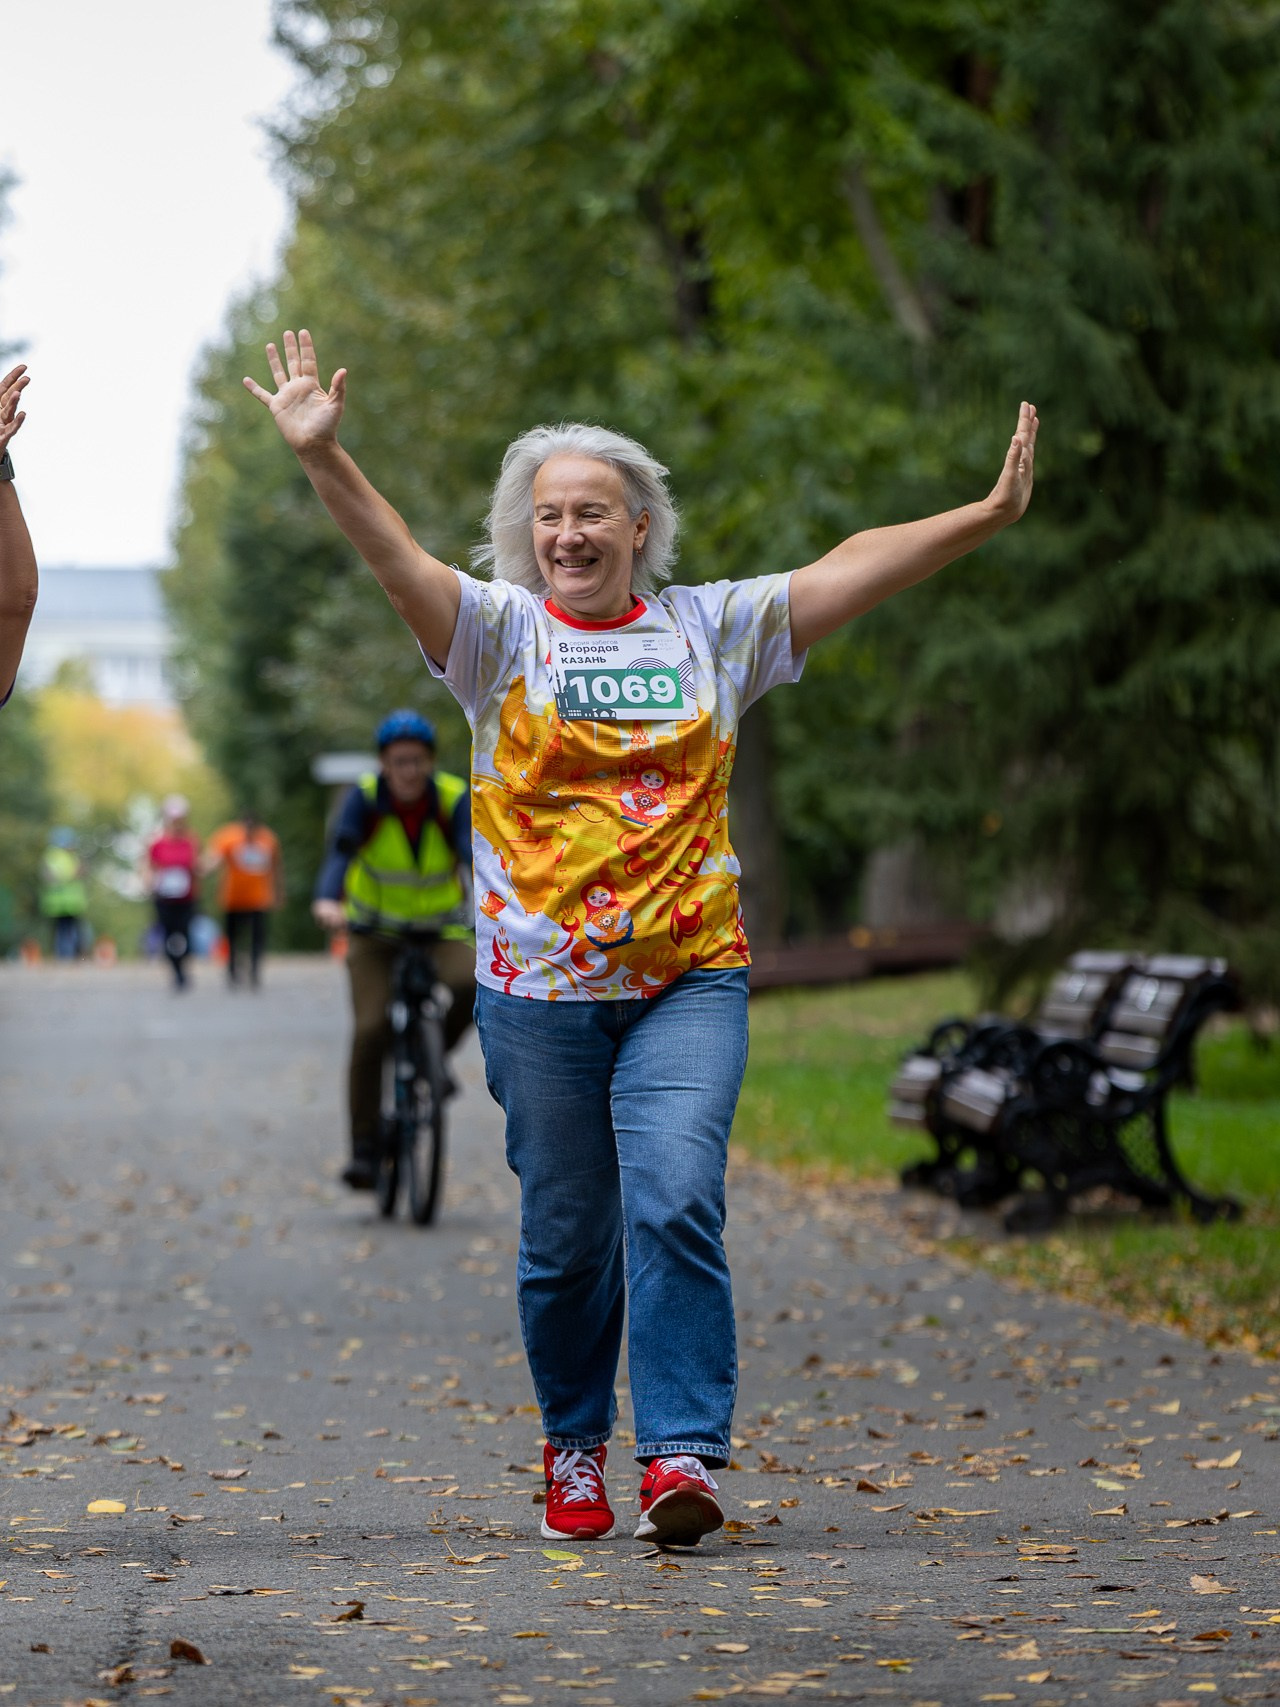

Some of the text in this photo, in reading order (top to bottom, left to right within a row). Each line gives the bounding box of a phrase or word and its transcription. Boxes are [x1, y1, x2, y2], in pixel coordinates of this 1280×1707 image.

[558, 642, 619, 654] 8 городов
[561, 656, 607, 664] КАЗАНЬ
[569, 675, 677, 704] 1069
